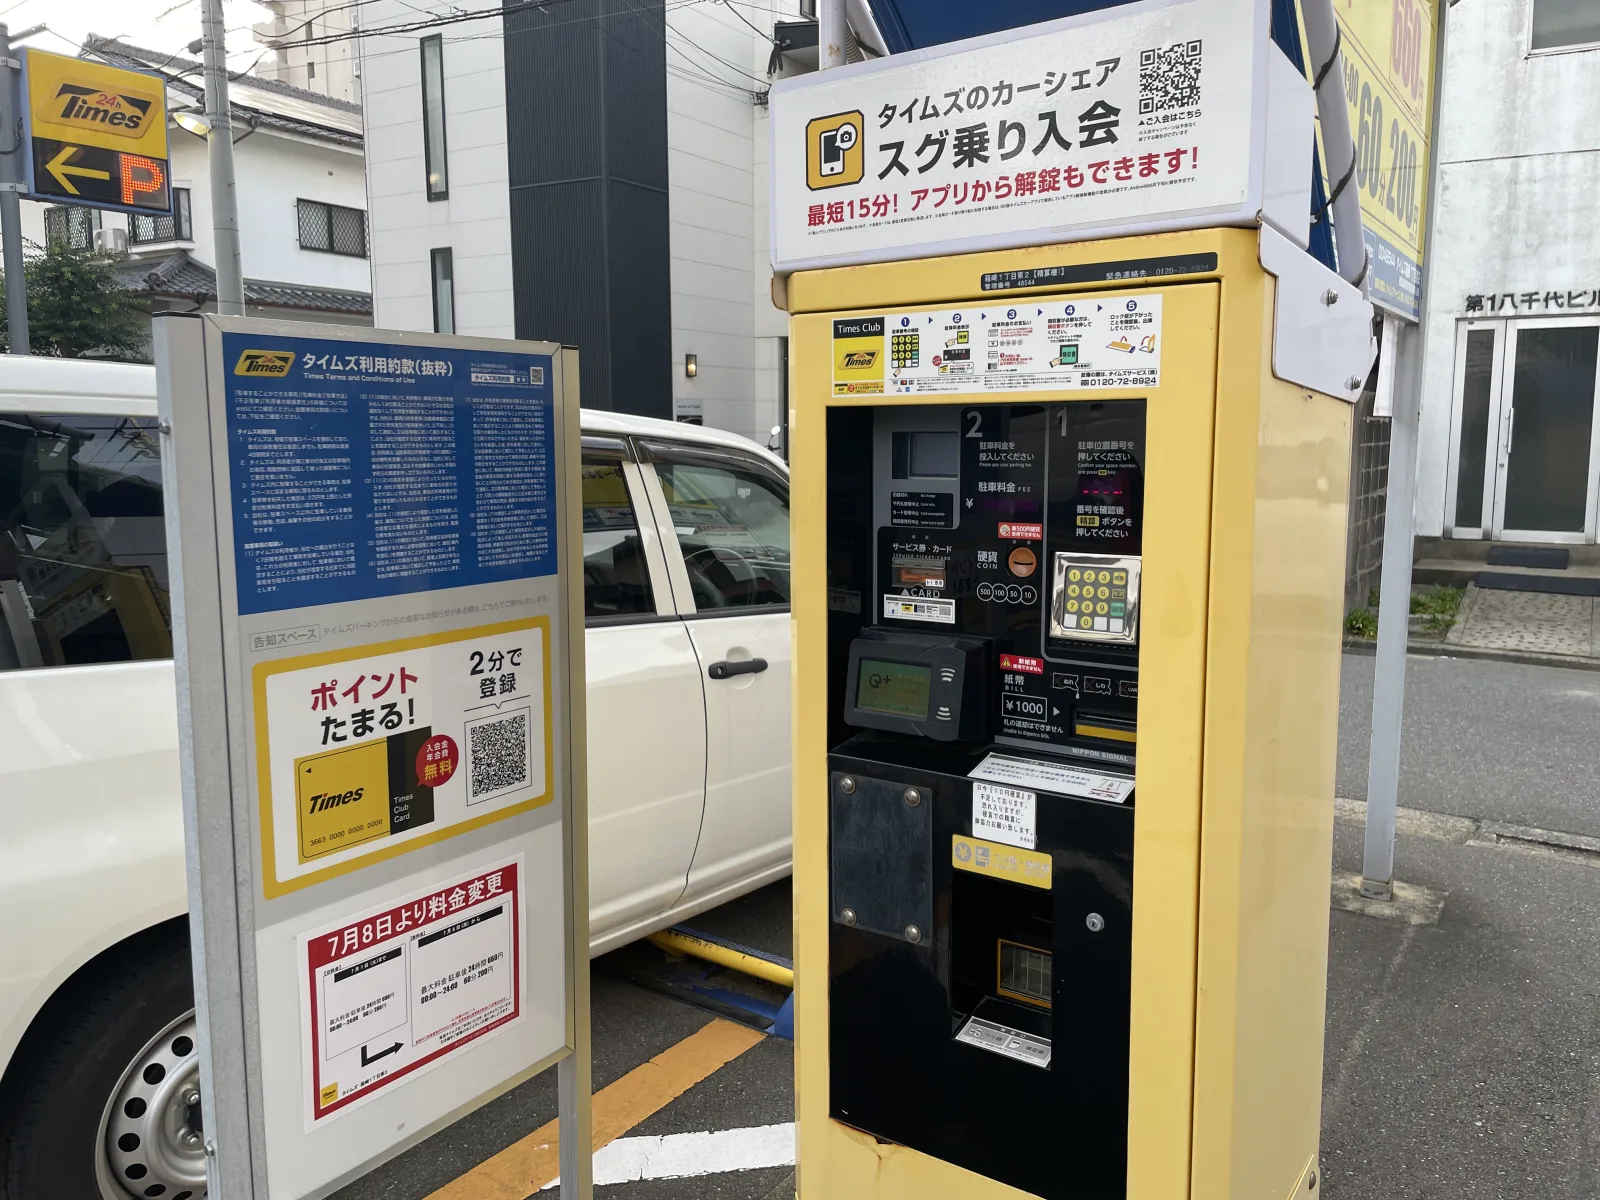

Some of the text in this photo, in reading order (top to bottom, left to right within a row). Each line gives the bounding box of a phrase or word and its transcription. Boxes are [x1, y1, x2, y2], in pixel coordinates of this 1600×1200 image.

[878, 57, 1121, 129] タイムズのカーシェア
[57, 92, 146, 130] Times
[878, 100, 1121, 180] スグ乗り入会
[120, 153, 164, 205] P
[808, 194, 898, 227] 最短15分!
[911, 146, 1199, 211] アプリから解錠もできます!
[1017, 279, 1035, 287] 48544
[837, 322, 881, 334] Times Club
[302, 352, 453, 377] タイムズ利用約款(抜粋)
[304, 372, 324, 380] Times
[326, 373, 347, 381] Terms
[361, 375, 395, 383] Conditions
[1090, 377, 1157, 387] 0120-72-8924
[965, 411, 983, 438] 2
[1057, 407, 1067, 437] 1
[979, 441, 1015, 450] 駐車料金を
[1078, 441, 1135, 450] 駐車位置番号を
[979, 452, 1035, 461] 投入してください
[1078, 452, 1131, 461] 押してください
[978, 482, 1016, 493] 駐車料金
[1077, 505, 1125, 515] 番号を確認後
[1080, 516, 1132, 527] 精算 ボタンを
[1076, 528, 1128, 538] 押してください
[977, 551, 998, 563] 硬貨
[911, 588, 941, 598] CARD
[995, 589, 1005, 597] 100
[1010, 590, 1017, 598] 50
[1025, 591, 1032, 599] 10
[254, 629, 317, 648] 告知スペース
[469, 648, 523, 676] 2分で
[479, 673, 516, 699] 登録
[1004, 674, 1025, 686] 紙幣
[311, 667, 418, 711] ポイント
[1005, 699, 1043, 714] ¥1000
[321, 698, 414, 745] たまる!
[426, 740, 448, 753] 入会金
[426, 751, 449, 762] 年会費
[1072, 747, 1128, 763] NIPPON SIGNAL
[424, 759, 452, 780] 無料
[309, 787, 364, 814] Times
[394, 794, 414, 804] Times
[394, 803, 409, 814] Club
[394, 813, 410, 823] Card
[310, 819, 383, 846] 3663 0000 0000 0000
[328, 871, 503, 957] 7月8日より料金変更
